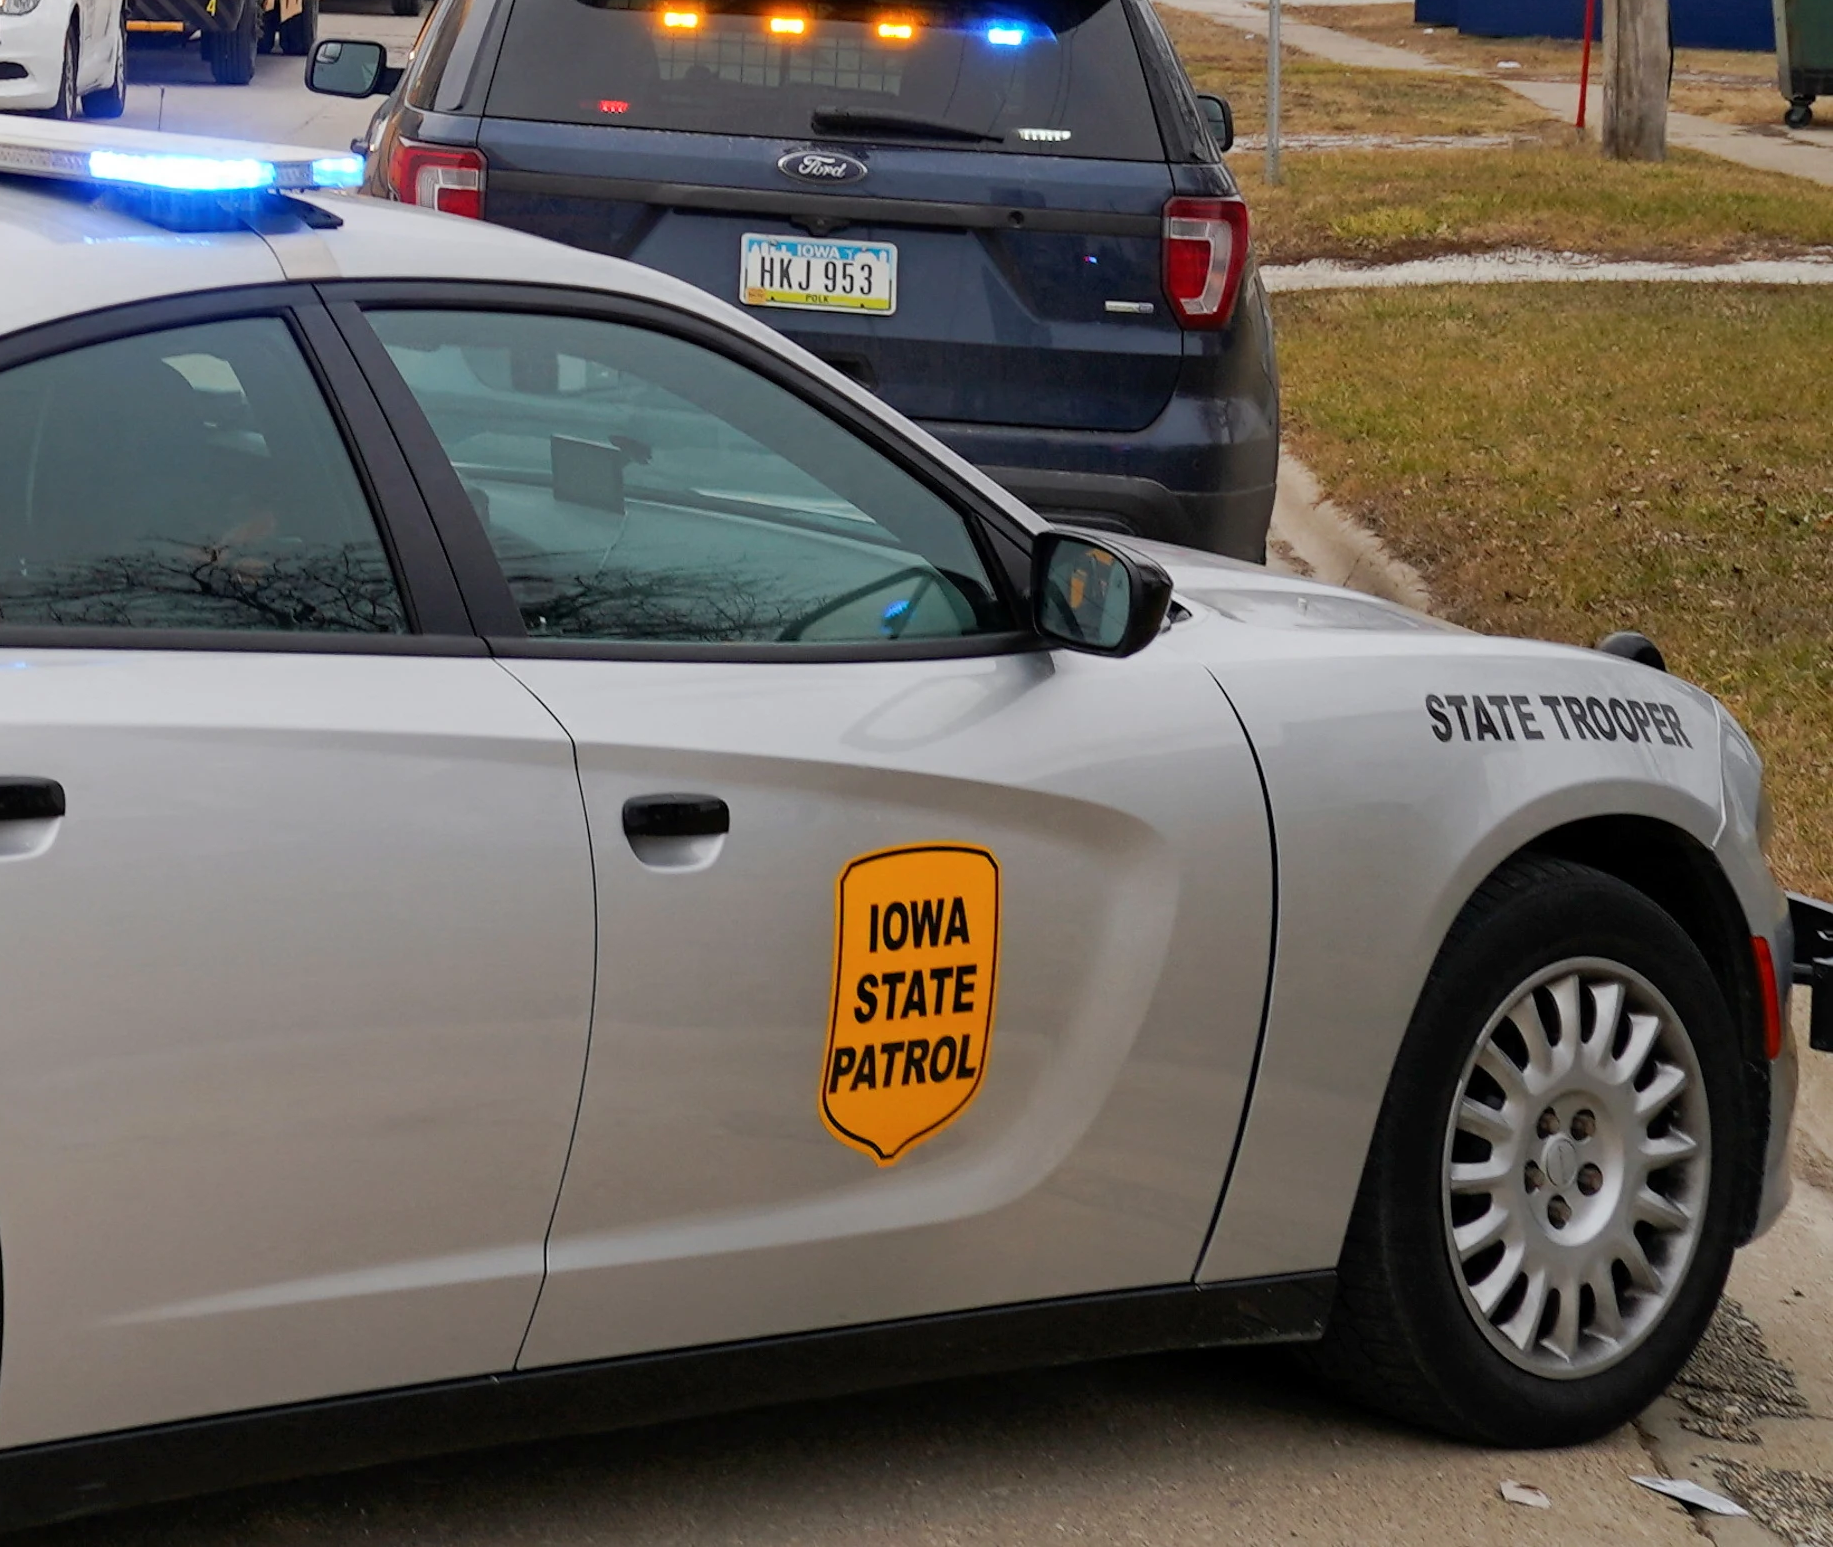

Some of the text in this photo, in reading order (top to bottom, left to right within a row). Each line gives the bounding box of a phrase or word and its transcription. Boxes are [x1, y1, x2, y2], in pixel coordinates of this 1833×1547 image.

[798, 155, 847, 178] Ford
[797, 244, 840, 259] IOWA
[760, 256, 873, 295] HKJ 953
[805, 294, 830, 303] POLK
[1425, 694, 1695, 750] STATE TROOPER
[869, 896, 971, 953] IOWA
[853, 964, 977, 1024] STATE
[828, 1034, 977, 1095] PATROL
